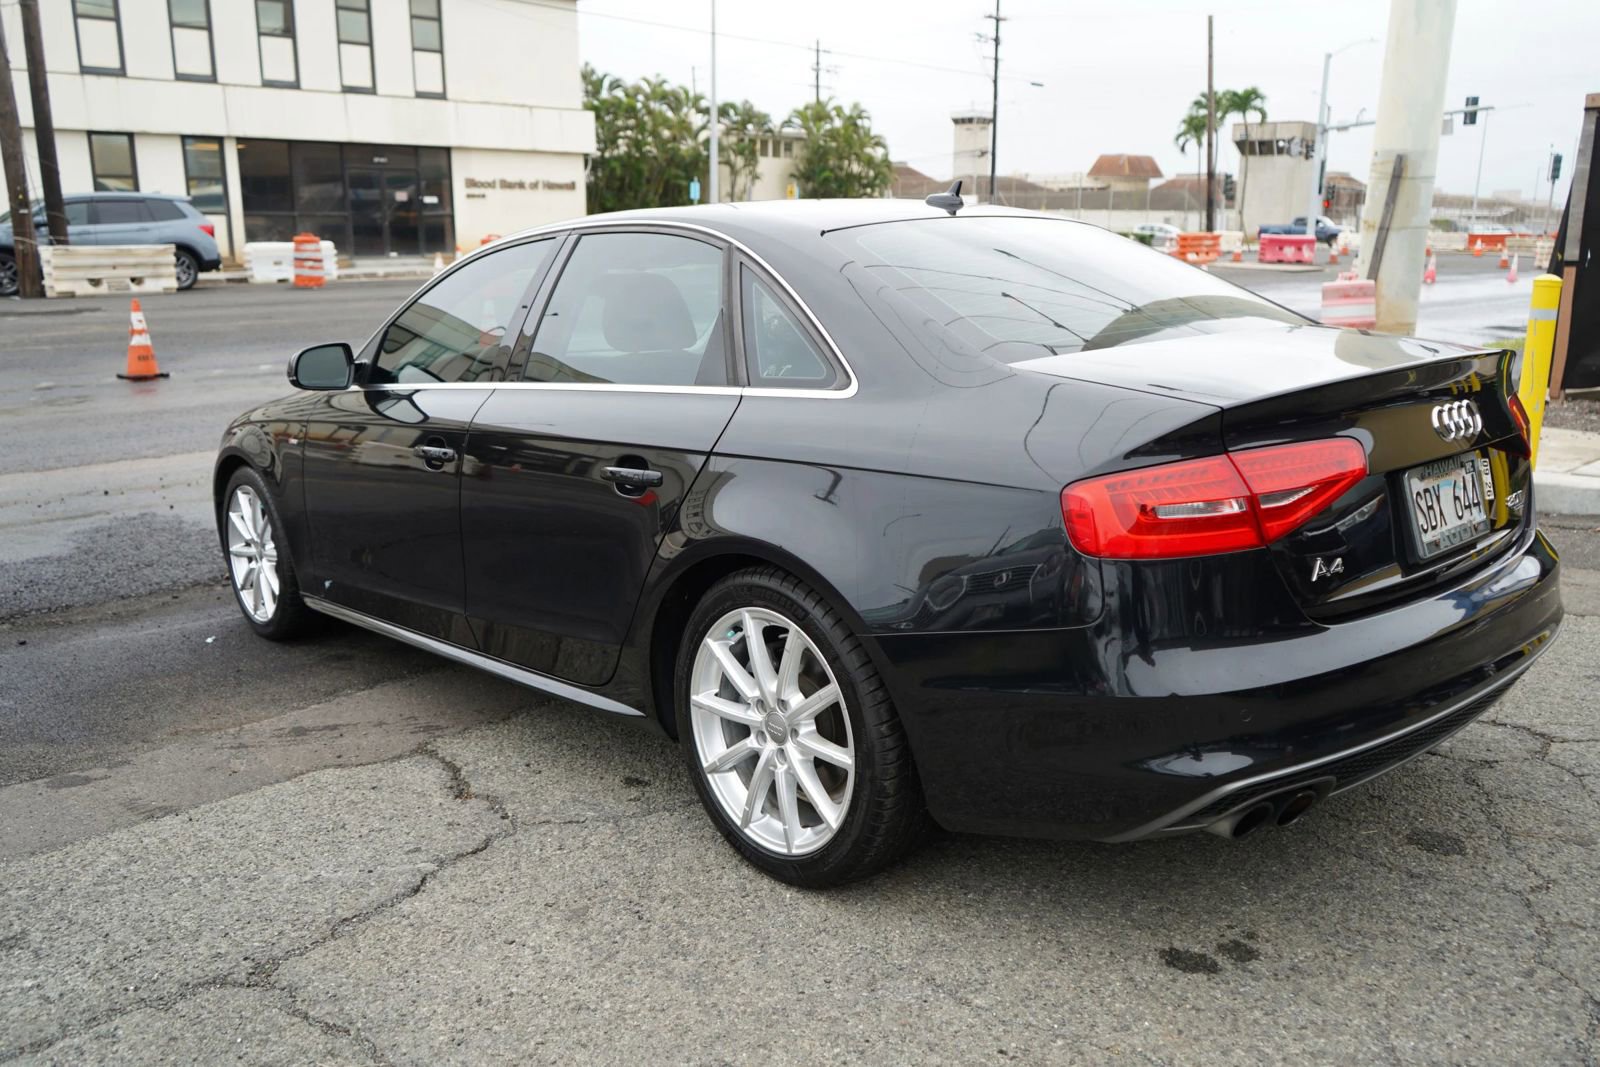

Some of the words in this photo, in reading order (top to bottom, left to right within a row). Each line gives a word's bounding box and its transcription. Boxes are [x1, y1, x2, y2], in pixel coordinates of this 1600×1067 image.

[1415, 484, 1447, 534] SBX
[1453, 474, 1482, 520] 644
[1311, 557, 1344, 581] A4
